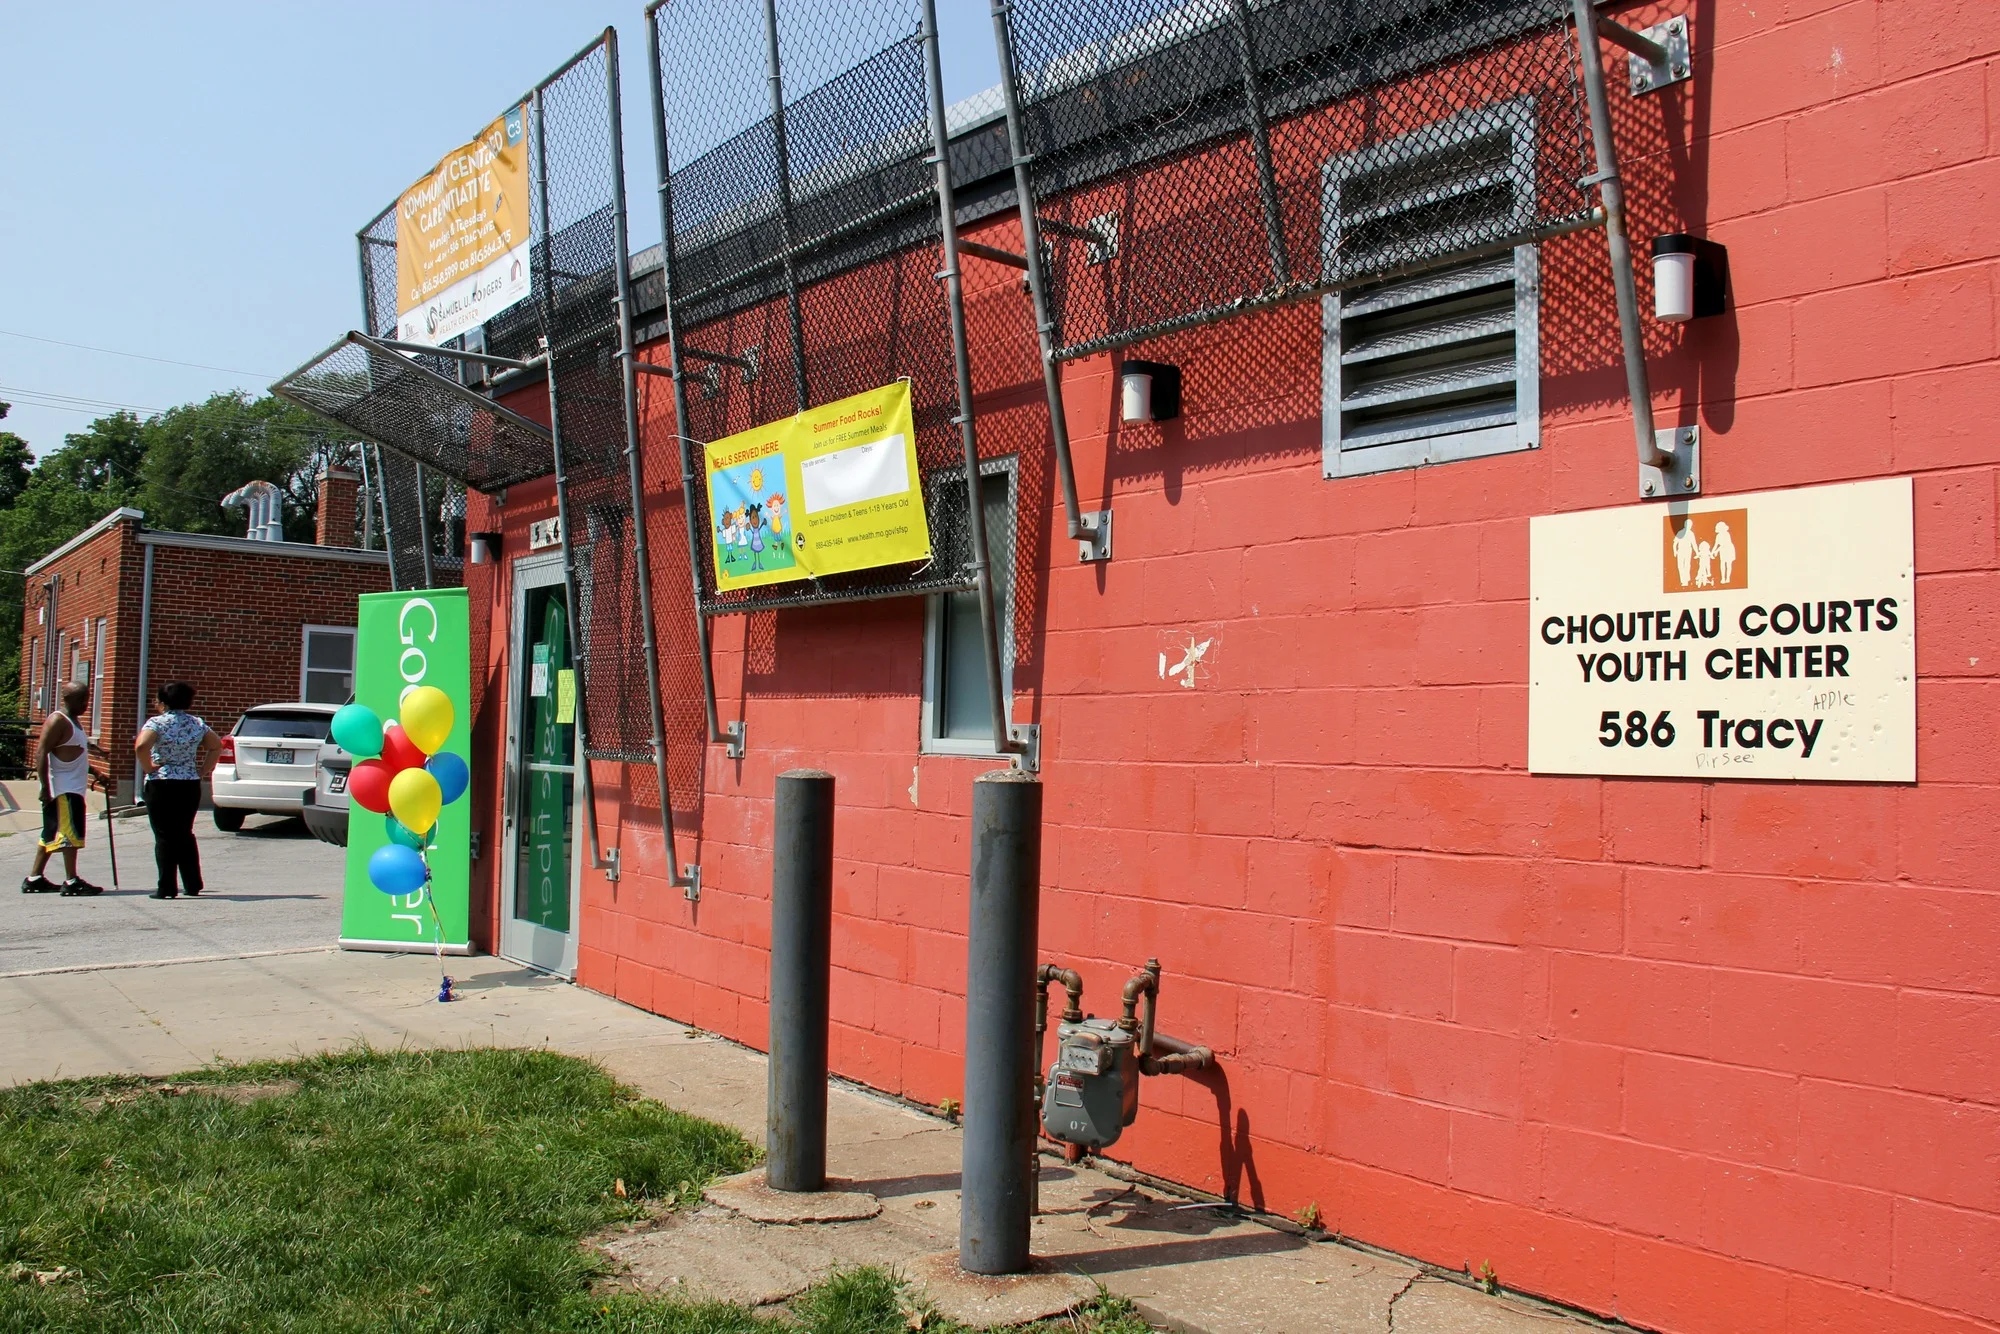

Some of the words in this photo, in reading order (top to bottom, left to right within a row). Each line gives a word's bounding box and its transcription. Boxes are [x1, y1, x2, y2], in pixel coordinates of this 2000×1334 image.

[507, 120, 521, 138] C3
[813, 419, 838, 433] Summer
[839, 413, 856, 426] Food
[858, 405, 883, 420] Rocks!
[813, 440, 822, 449] Join
[835, 433, 847, 443] FREE
[847, 428, 869, 440] Summer
[870, 422, 888, 434] Meals
[734, 447, 759, 463] SERVED
[760, 440, 779, 455] HERE
[809, 519, 819, 527] Open
[830, 512, 847, 522] Children
[848, 510, 852, 518] &
[852, 507, 868, 517] Teens
[881, 501, 898, 511] Years
[898, 498, 909, 508] Old
[1541, 607, 1720, 645] CHOUTEAU
[1739, 597, 1898, 637] COURTS
[1577, 650, 1687, 683] YOUTH
[1705, 644, 1849, 680] CENTER
[1598, 710, 1676, 748] 586
[1697, 710, 1824, 758] Tracy
[1070, 1120, 1088, 1132] 07
